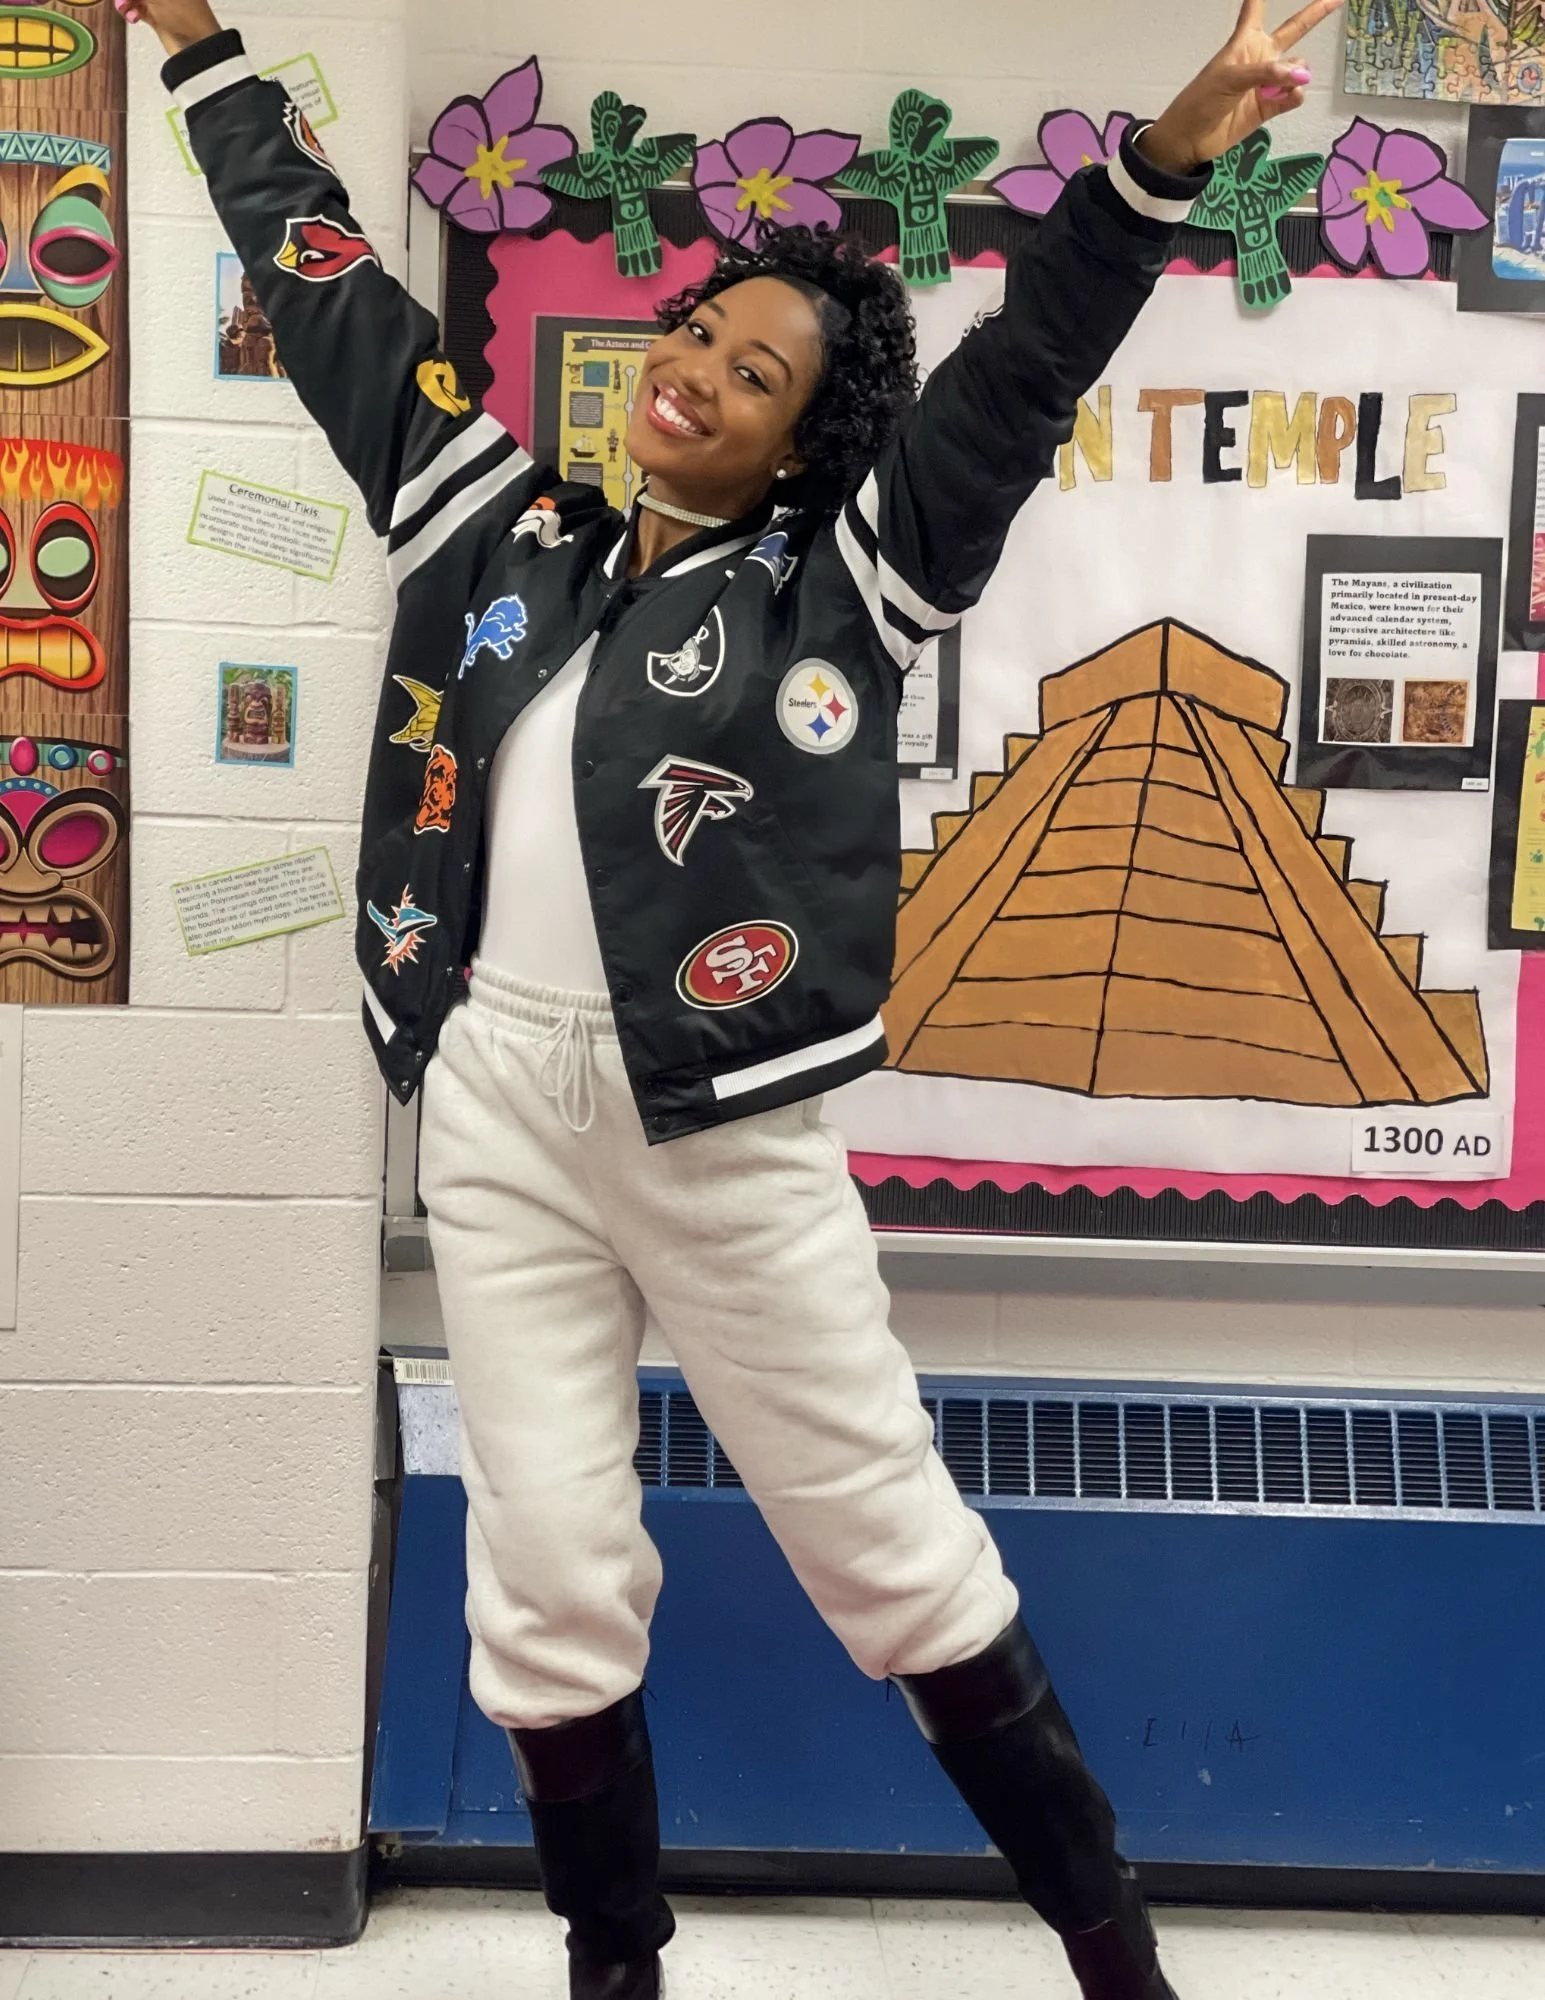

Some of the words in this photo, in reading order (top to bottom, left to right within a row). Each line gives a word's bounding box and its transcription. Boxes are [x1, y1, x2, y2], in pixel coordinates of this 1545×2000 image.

[591, 339, 605, 348] The
[630, 341, 645, 349] and
[1137, 388, 1457, 500] TEMPLE
[228, 483, 290, 509] Ceremonial
[1331, 591, 1374, 600] primarily
[1423, 594, 1477, 603] present-day
[1331, 602, 1366, 611] Mexico,
[1394, 604, 1424, 612] known
[1443, 605, 1464, 613] their
[1376, 615, 1414, 623] calendar
[1417, 617, 1451, 625] system,
[1330, 626, 1378, 635] impressive
[1377, 639, 1406, 647] skilled
[788, 697, 817, 710] Steelers
[208, 875, 232, 886] carved
[705, 934, 777, 995] SF
[1364, 1125, 1444, 1155] 1300
[1453, 1134, 1491, 1157] AD
